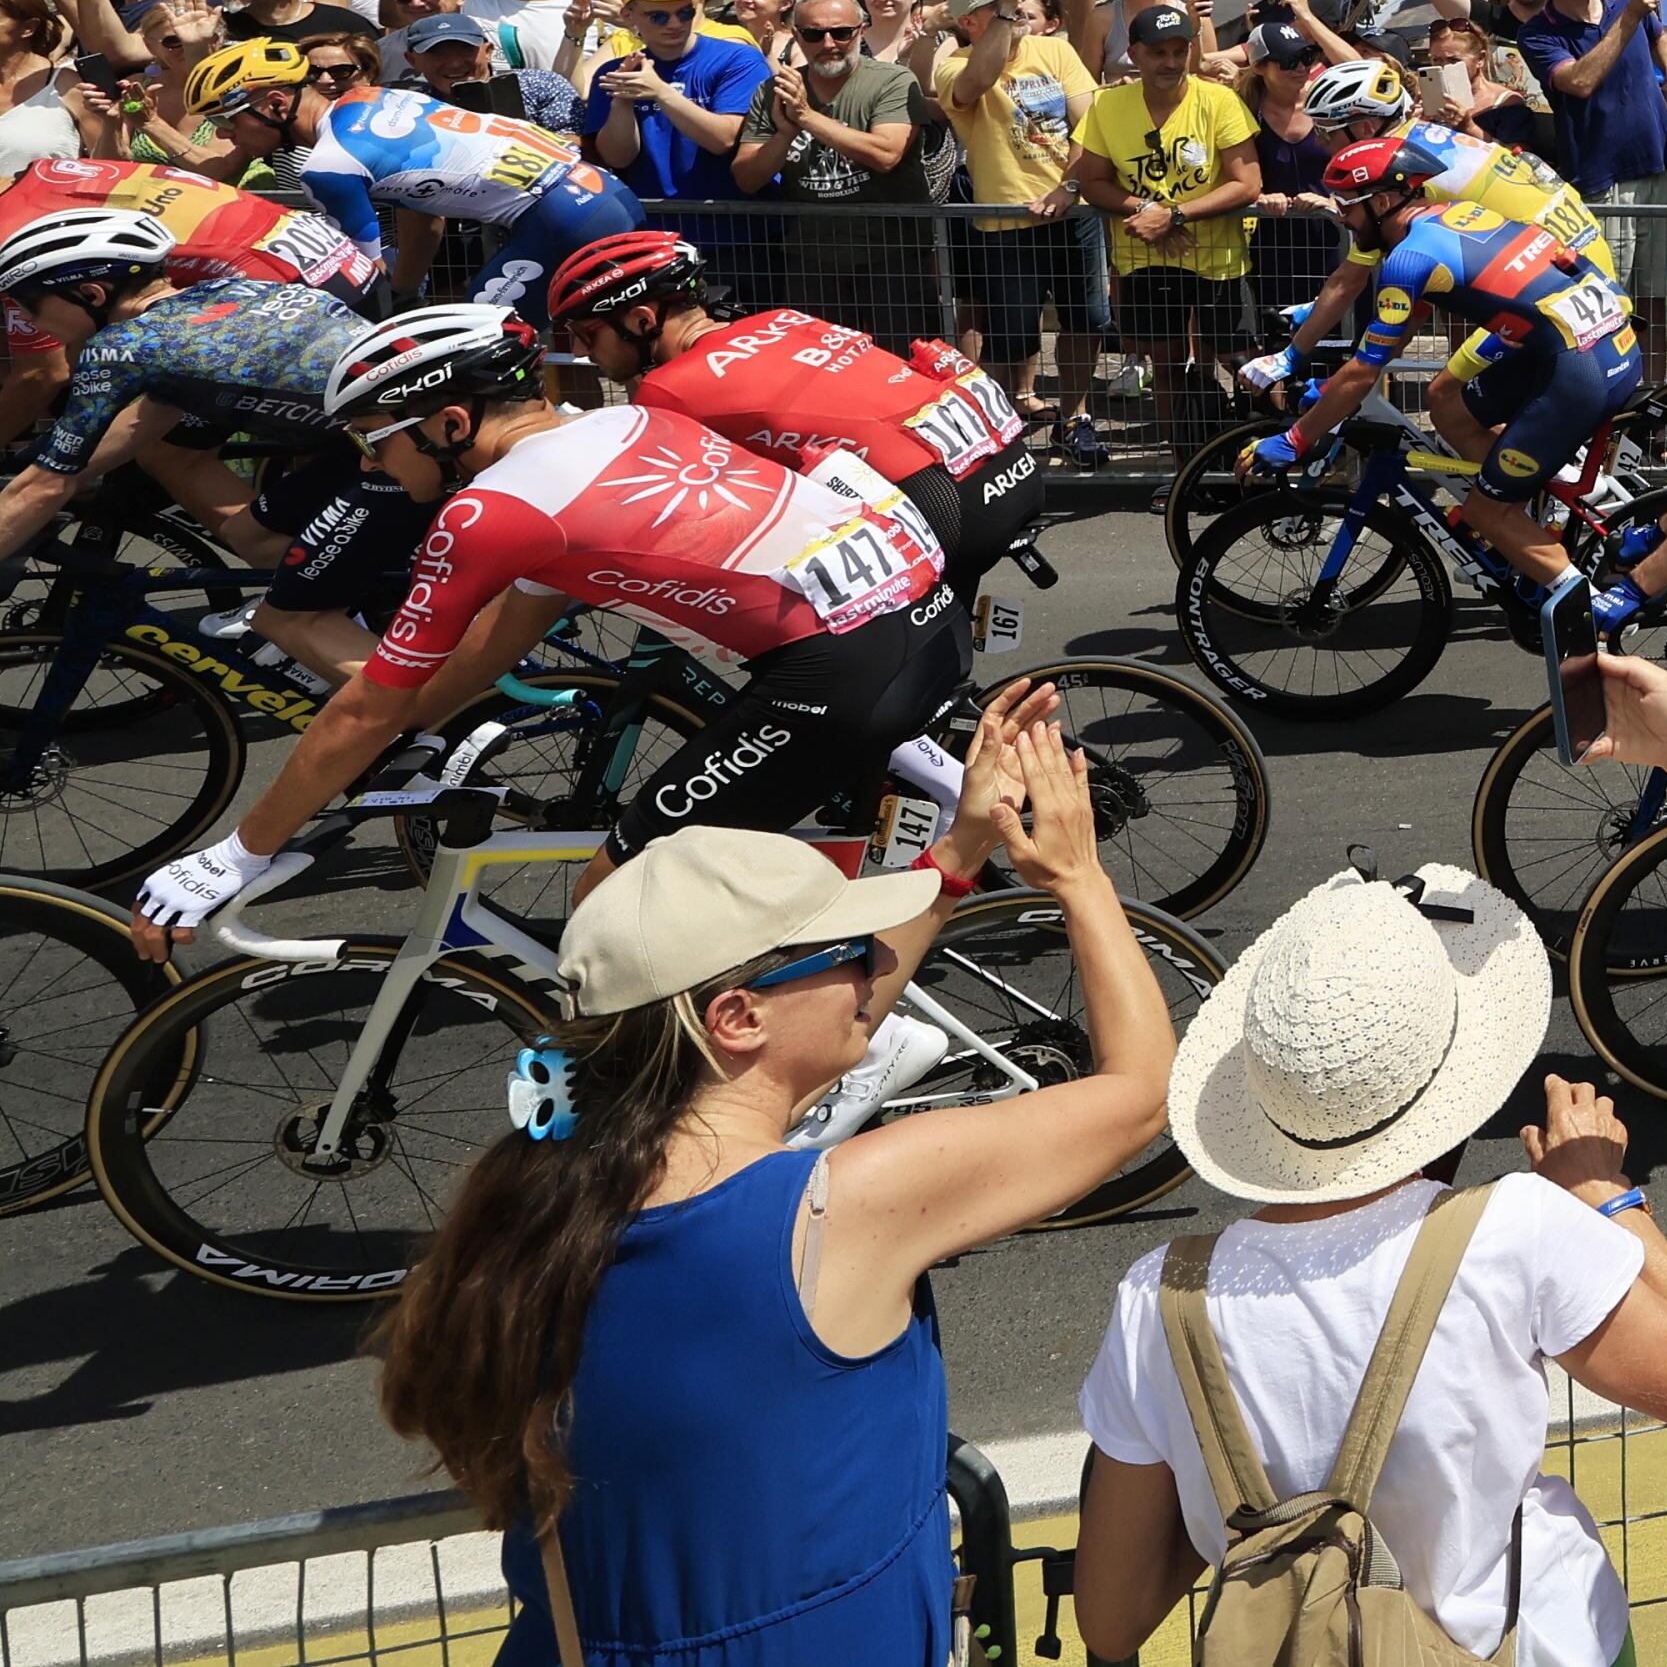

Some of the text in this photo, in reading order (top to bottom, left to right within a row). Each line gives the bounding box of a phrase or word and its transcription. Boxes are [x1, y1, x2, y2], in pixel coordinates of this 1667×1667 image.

[1336, 142, 1387, 163] TREK
[818, 186, 860, 199] HONOLULU
[1543, 197, 1590, 245] 181
[1503, 234, 1557, 272] TRE
[581, 274, 613, 296] ARKEA
[1575, 284, 1614, 329] 42
[73, 368, 112, 382] ease
[366, 349, 424, 382] Cofidis
[235, 394, 351, 430] BETCITY
[983, 452, 1037, 505] ARKEA
[1616, 450, 1640, 474] 42
[301, 496, 351, 547] VISMA
[1395, 483, 1500, 596] TREK
[154, 533, 201, 566] SWISS
[391, 498, 484, 644] Cofidis
[804, 528, 895, 610] 147
[587, 569, 737, 615] Cofidis
[1409, 553, 1435, 602] AEOLUS
[992, 605, 1019, 640] 167
[1188, 556, 1269, 702] BONTRAGER
[655, 723, 792, 818] Cofidis
[896, 807, 932, 850] 147
